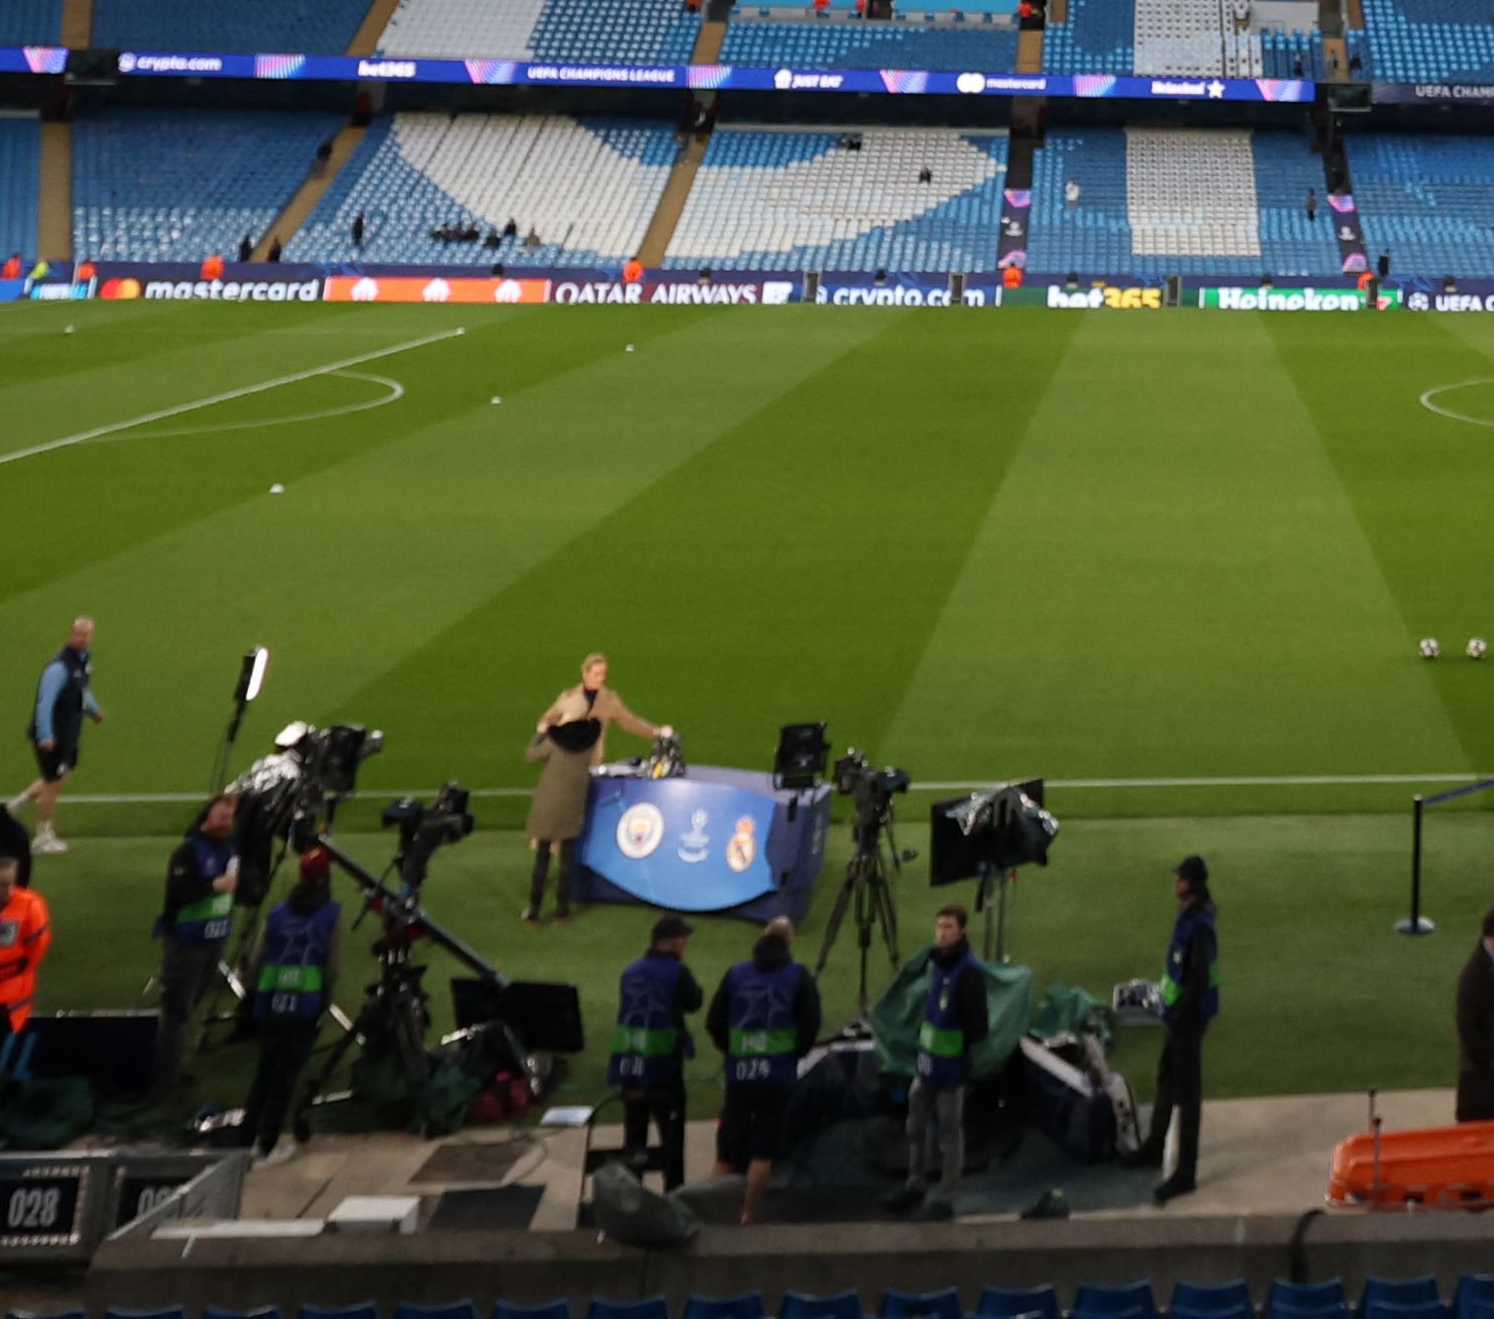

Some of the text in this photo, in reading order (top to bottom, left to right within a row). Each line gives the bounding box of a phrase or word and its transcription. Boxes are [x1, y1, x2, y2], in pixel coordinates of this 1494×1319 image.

[1415, 85, 1451, 98] UEFA
[144, 278, 319, 301] mastercard
[555, 282, 642, 305] QATAR
[651, 283, 757, 305] AIRWAYS
[1435, 294, 1482, 312] UEFA
[6, 1186, 59, 1228] 028
